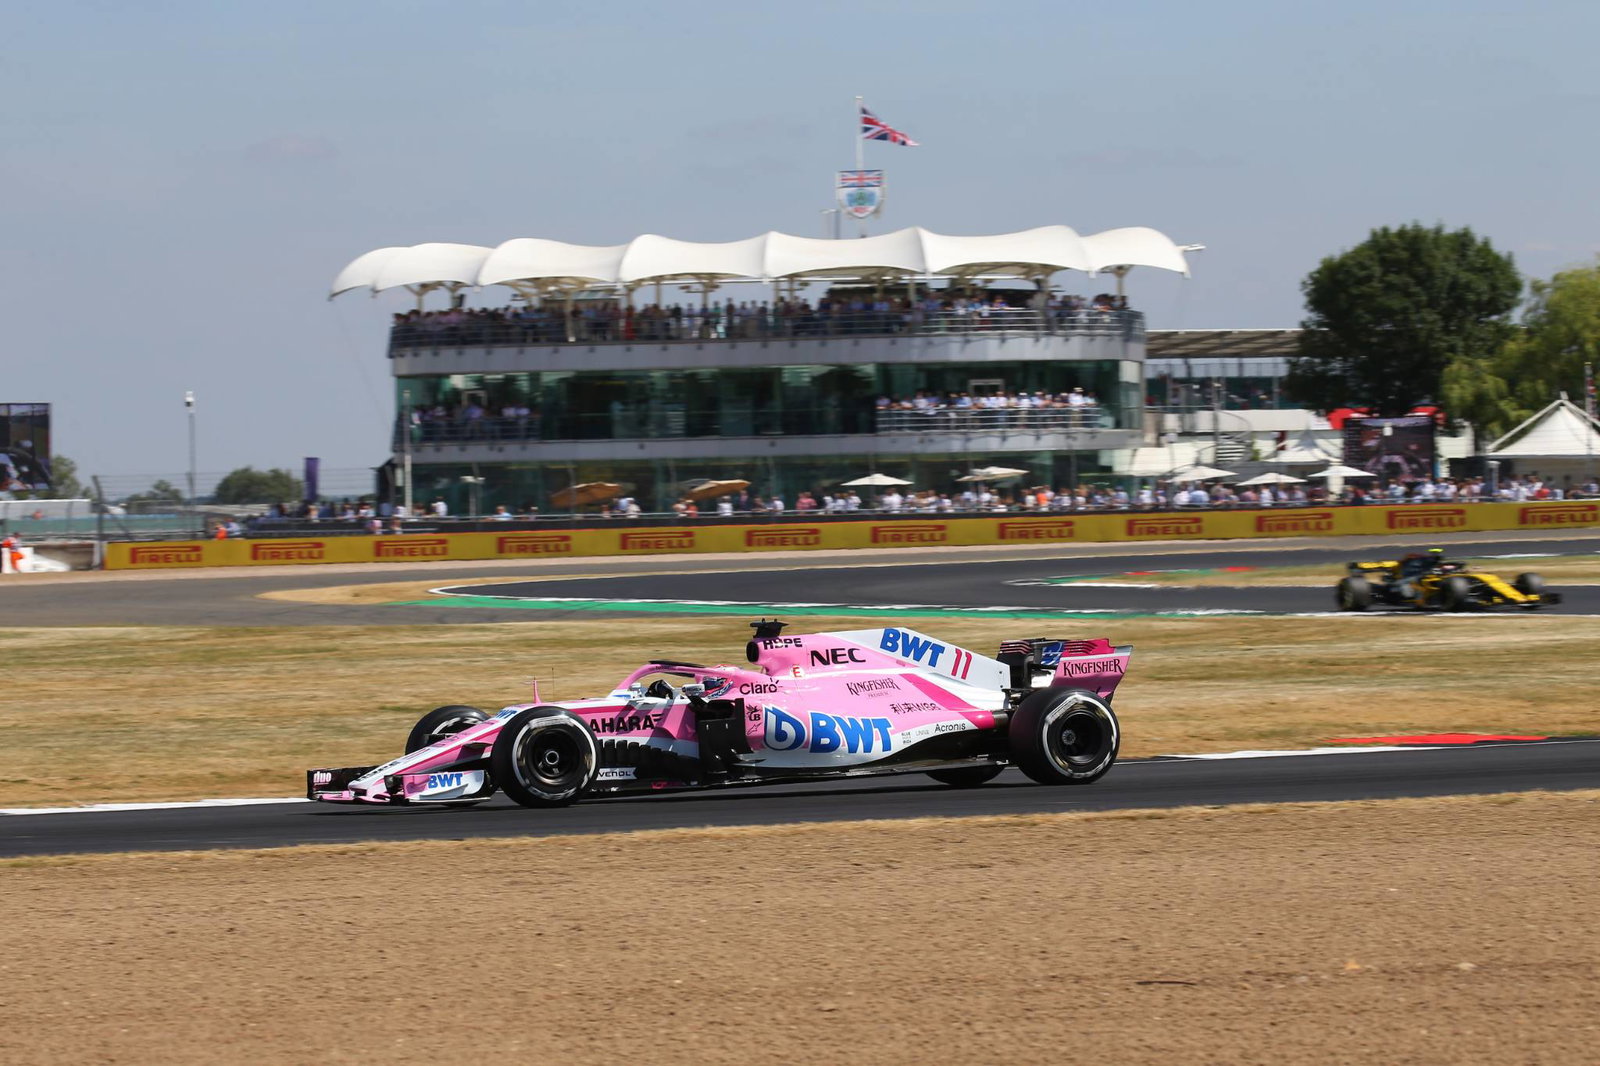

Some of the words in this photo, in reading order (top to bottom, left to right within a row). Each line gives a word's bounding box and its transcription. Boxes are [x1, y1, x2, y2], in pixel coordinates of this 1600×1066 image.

[1255, 512, 1334, 532] PIRELLI
[1387, 509, 1466, 529] PIRELLI
[1518, 505, 1600, 525] PIRELLI
[870, 524, 947, 543] PIRELLI
[998, 520, 1074, 540] PIRELLI
[1126, 517, 1202, 536] PIRELLI
[497, 535, 571, 554] PIRELLI
[620, 531, 694, 550] PIRELLI
[745, 528, 820, 547] PIRELLI
[129, 545, 203, 564] PIRELLI
[250, 542, 325, 561] PIRELLI
[374, 539, 448, 557] PIRELLI
[810, 648, 866, 667] NEC
[880, 628, 945, 668] BWT
[951, 648, 973, 680] 11
[1063, 658, 1124, 678] KINGFISHER
[740, 682, 778, 695] Claro
[846, 677, 901, 696] KINGFISHER
[589, 714, 657, 734] AHARA
[808, 711, 893, 754] BWT
[934, 722, 966, 733] Acronis
[428, 773, 463, 788] BWT
[598, 770, 632, 778] VENOL
